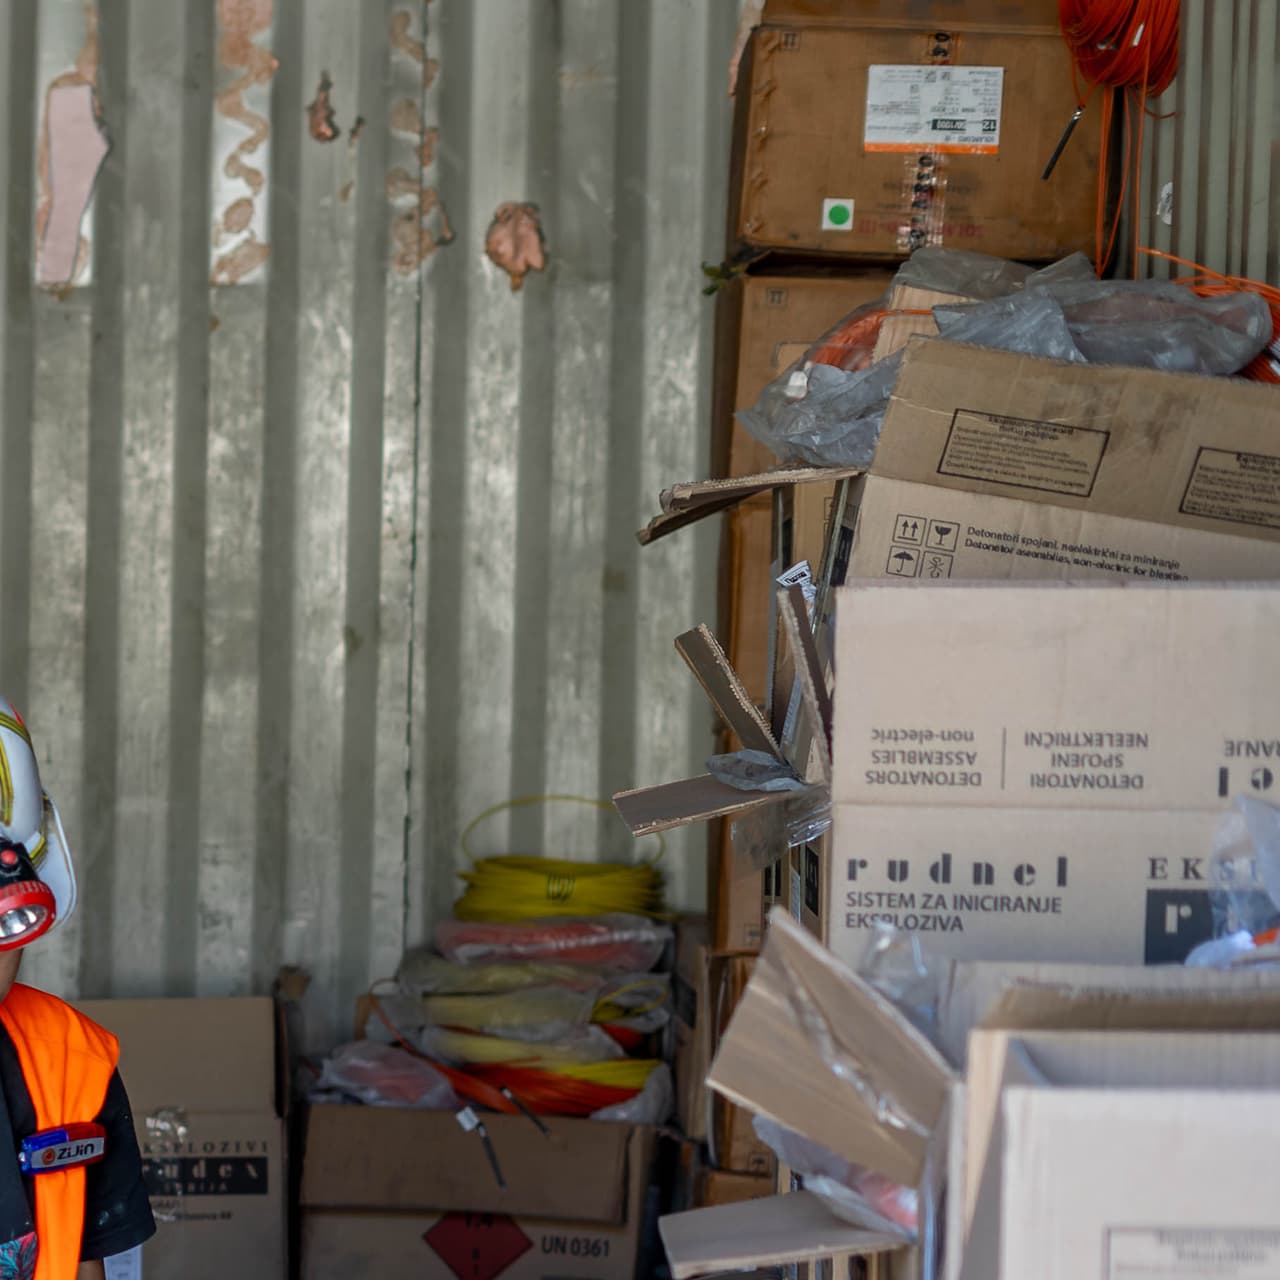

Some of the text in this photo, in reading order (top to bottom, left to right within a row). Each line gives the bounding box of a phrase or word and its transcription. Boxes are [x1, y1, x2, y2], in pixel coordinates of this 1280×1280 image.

[870, 728, 975, 744] non-electric
[1024, 729, 1149, 749] NEELEKTRIČNI
[871, 749, 978, 766] ASSEMBLIES
[1050, 752, 1125, 769] SPOJENI
[865, 769, 983, 787] DETONATORS
[1030, 773, 1144, 790] DETONATORI
[847, 853, 1070, 888] rudnel
[846, 891, 1063, 915] SISTEM ZA INICIRANJE
[845, 911, 964, 933] EKSPLOZIVA
[143, 1141, 268, 1154] KSPLOZIVI
[543, 1236, 609, 1257] UN 0361
